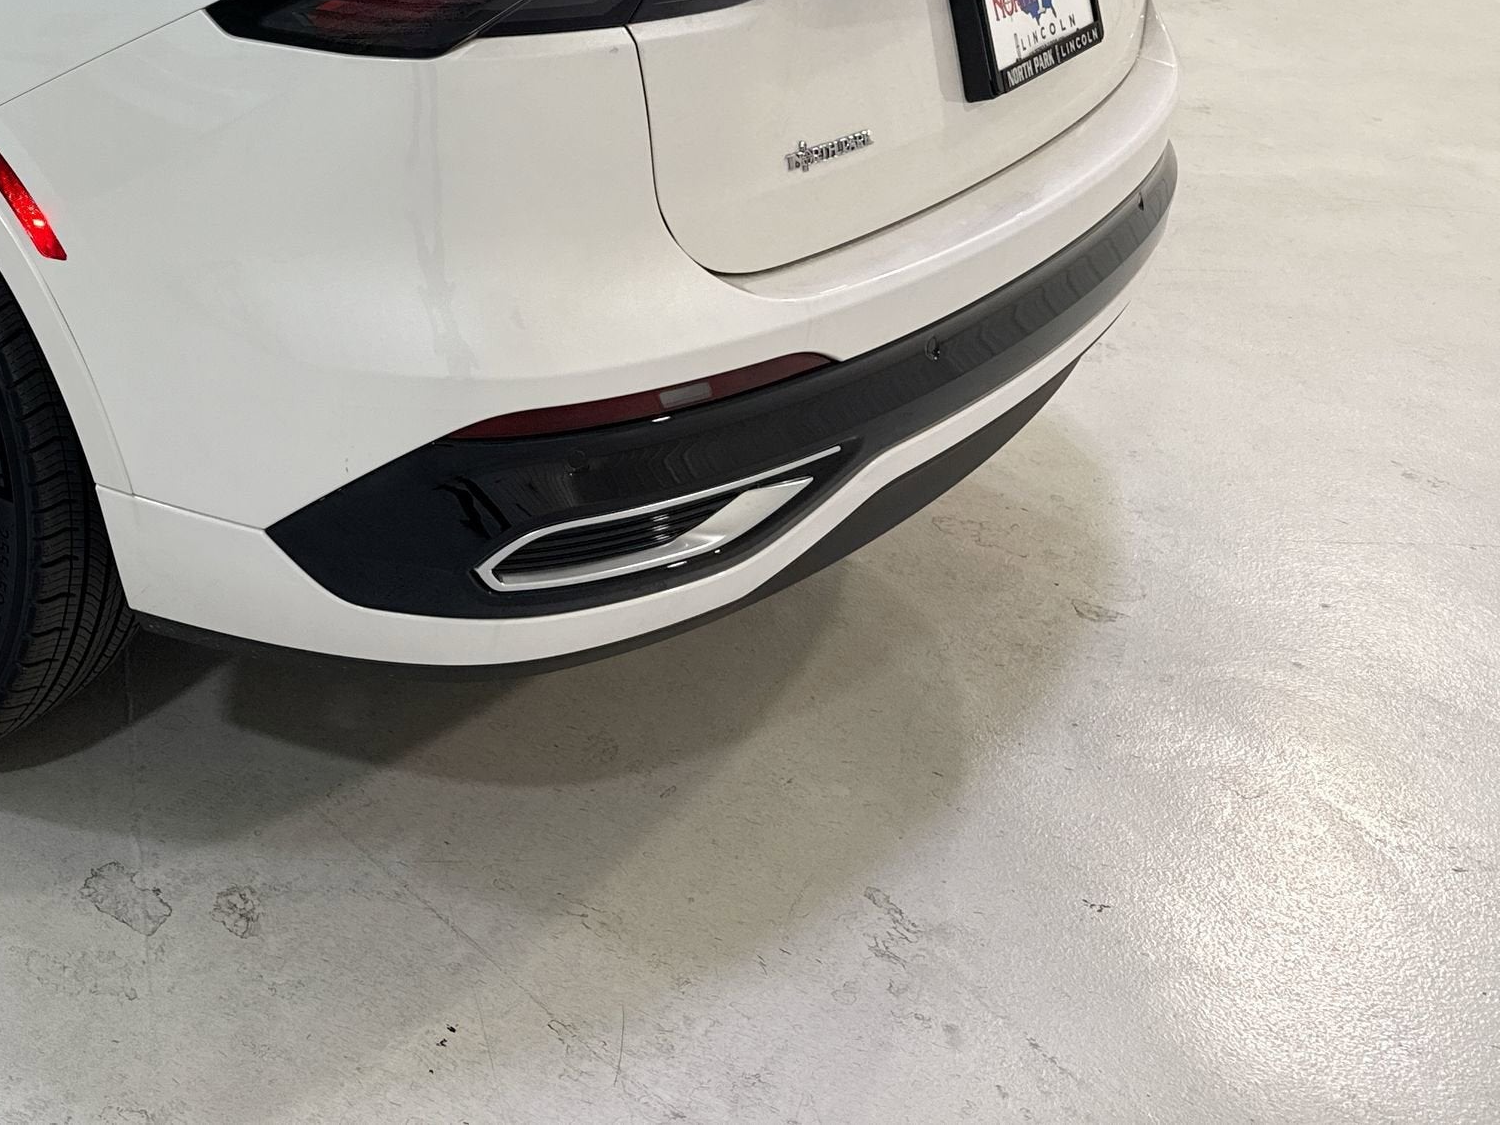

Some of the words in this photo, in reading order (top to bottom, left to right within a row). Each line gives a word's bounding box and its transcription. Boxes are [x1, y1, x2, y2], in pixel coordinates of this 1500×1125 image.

[1021, 14, 1076, 51] LINCOLN
[1007, 60, 1034, 87] NORTH
[1033, 49, 1055, 73] PARK
[1060, 27, 1099, 57] LINCOLN
